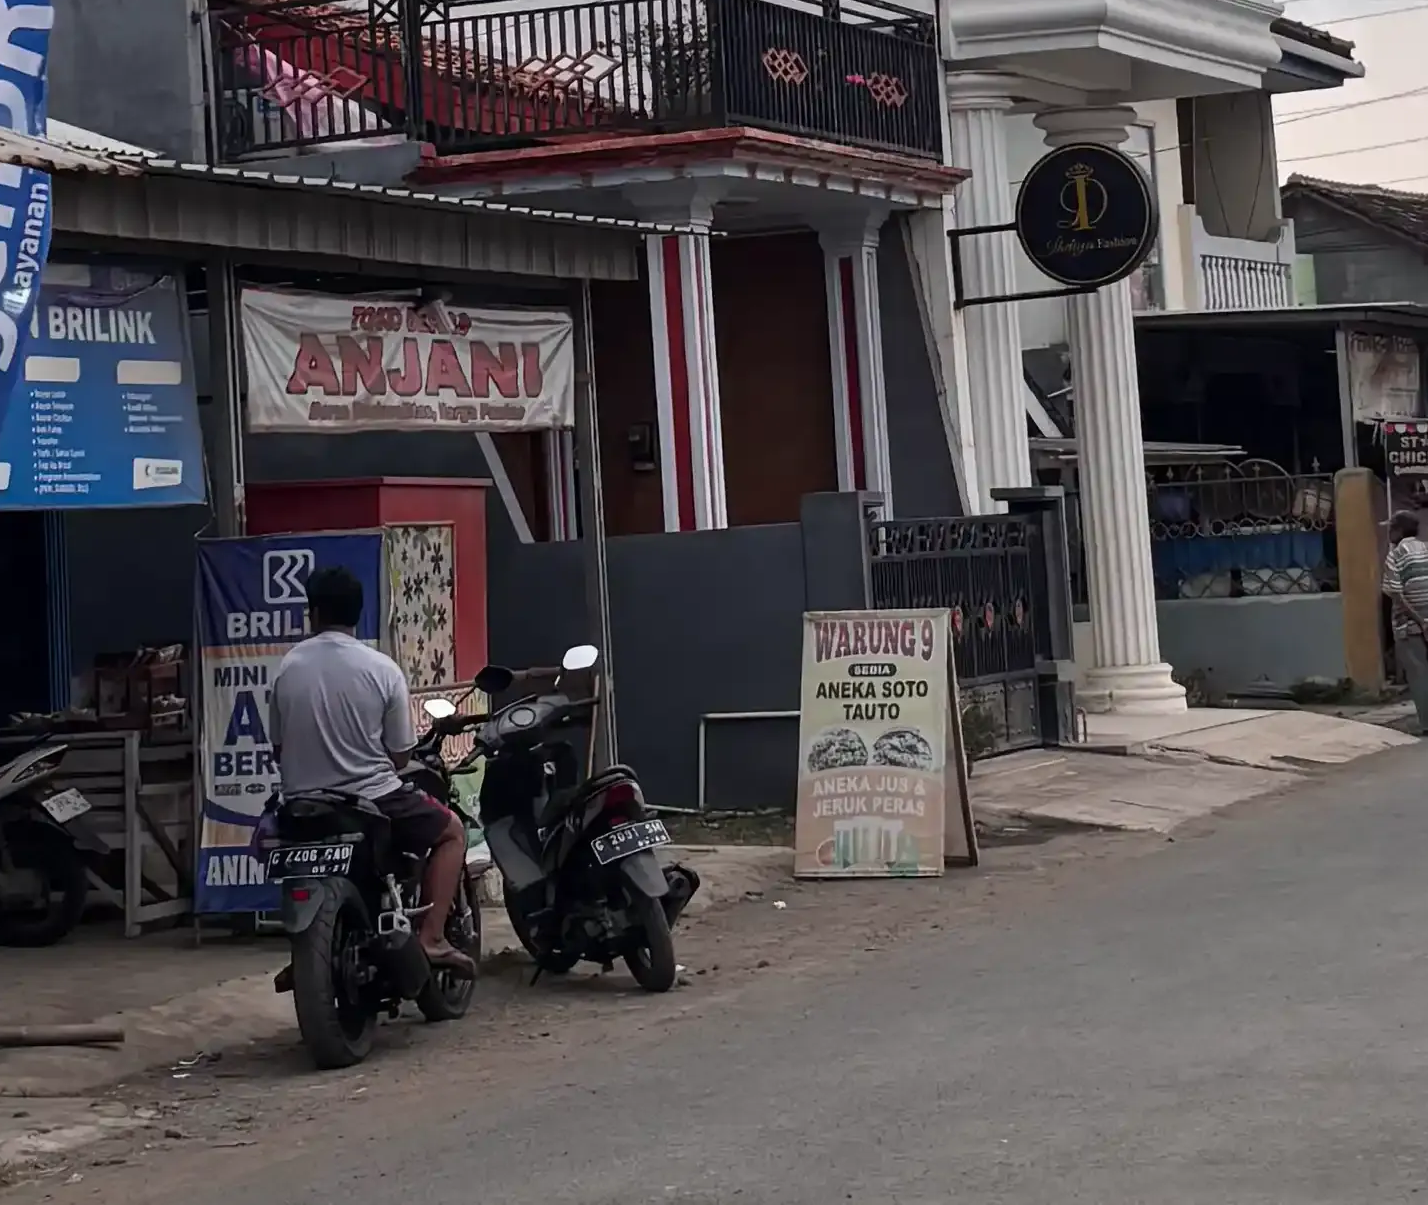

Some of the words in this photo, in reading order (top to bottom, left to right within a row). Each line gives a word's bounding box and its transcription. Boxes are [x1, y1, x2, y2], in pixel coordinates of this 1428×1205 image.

[47, 306, 157, 345] BRILINK
[285, 331, 544, 399] ANJANI
[815, 619, 916, 662] WARUNG
[921, 620, 934, 662] 9
[213, 666, 268, 689] MINI
[816, 680, 877, 699] ANEKA
[882, 680, 929, 698] SOTO
[843, 703, 901, 721] TAUTO
[812, 776, 871, 797] ANEKA
[876, 777, 909, 794] JUS
[813, 796, 868, 819] JERUK
[872, 796, 925, 818] PERAS
